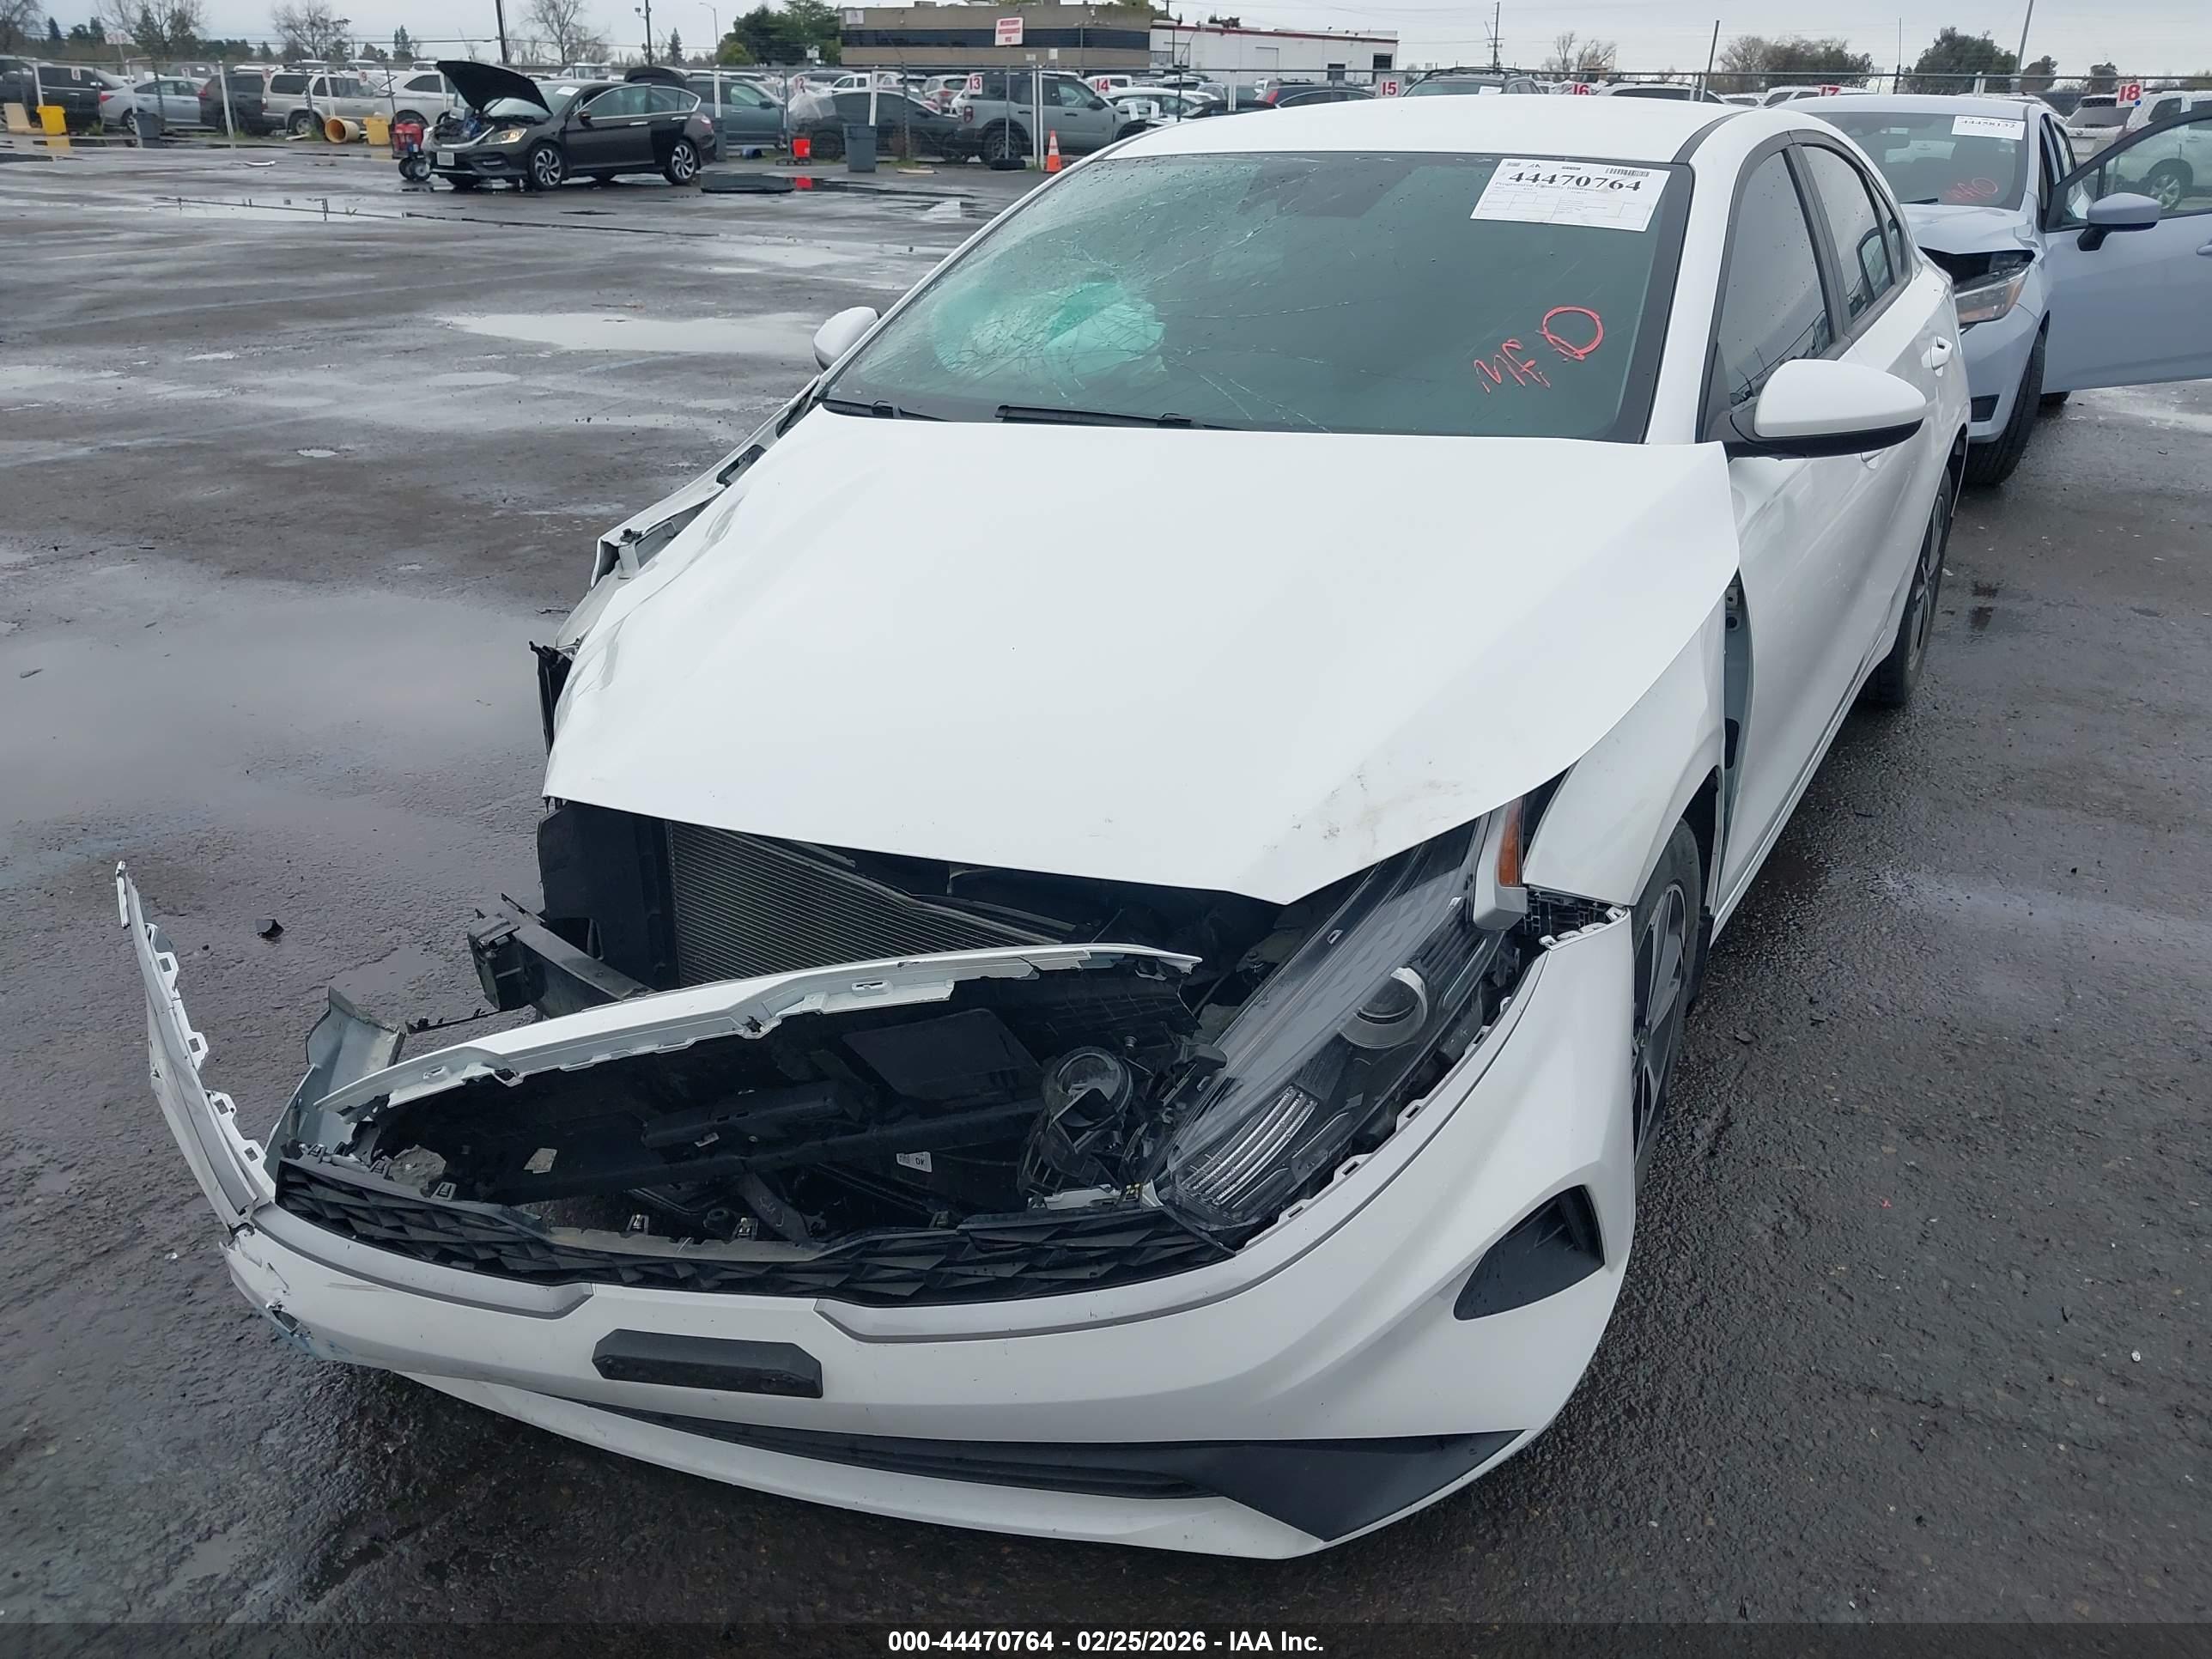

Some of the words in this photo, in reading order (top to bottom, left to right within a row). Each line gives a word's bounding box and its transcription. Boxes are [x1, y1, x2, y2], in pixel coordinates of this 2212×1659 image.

[969, 77, 981, 90] 13
[1097, 79, 1109, 92] 14
[1382, 82, 1396, 95] 15
[1573, 84, 1589, 95] 16
[1820, 86, 1839, 97] 17
[2119, 84, 2141, 101] 18
[1509, 172, 1642, 191] 44470764
